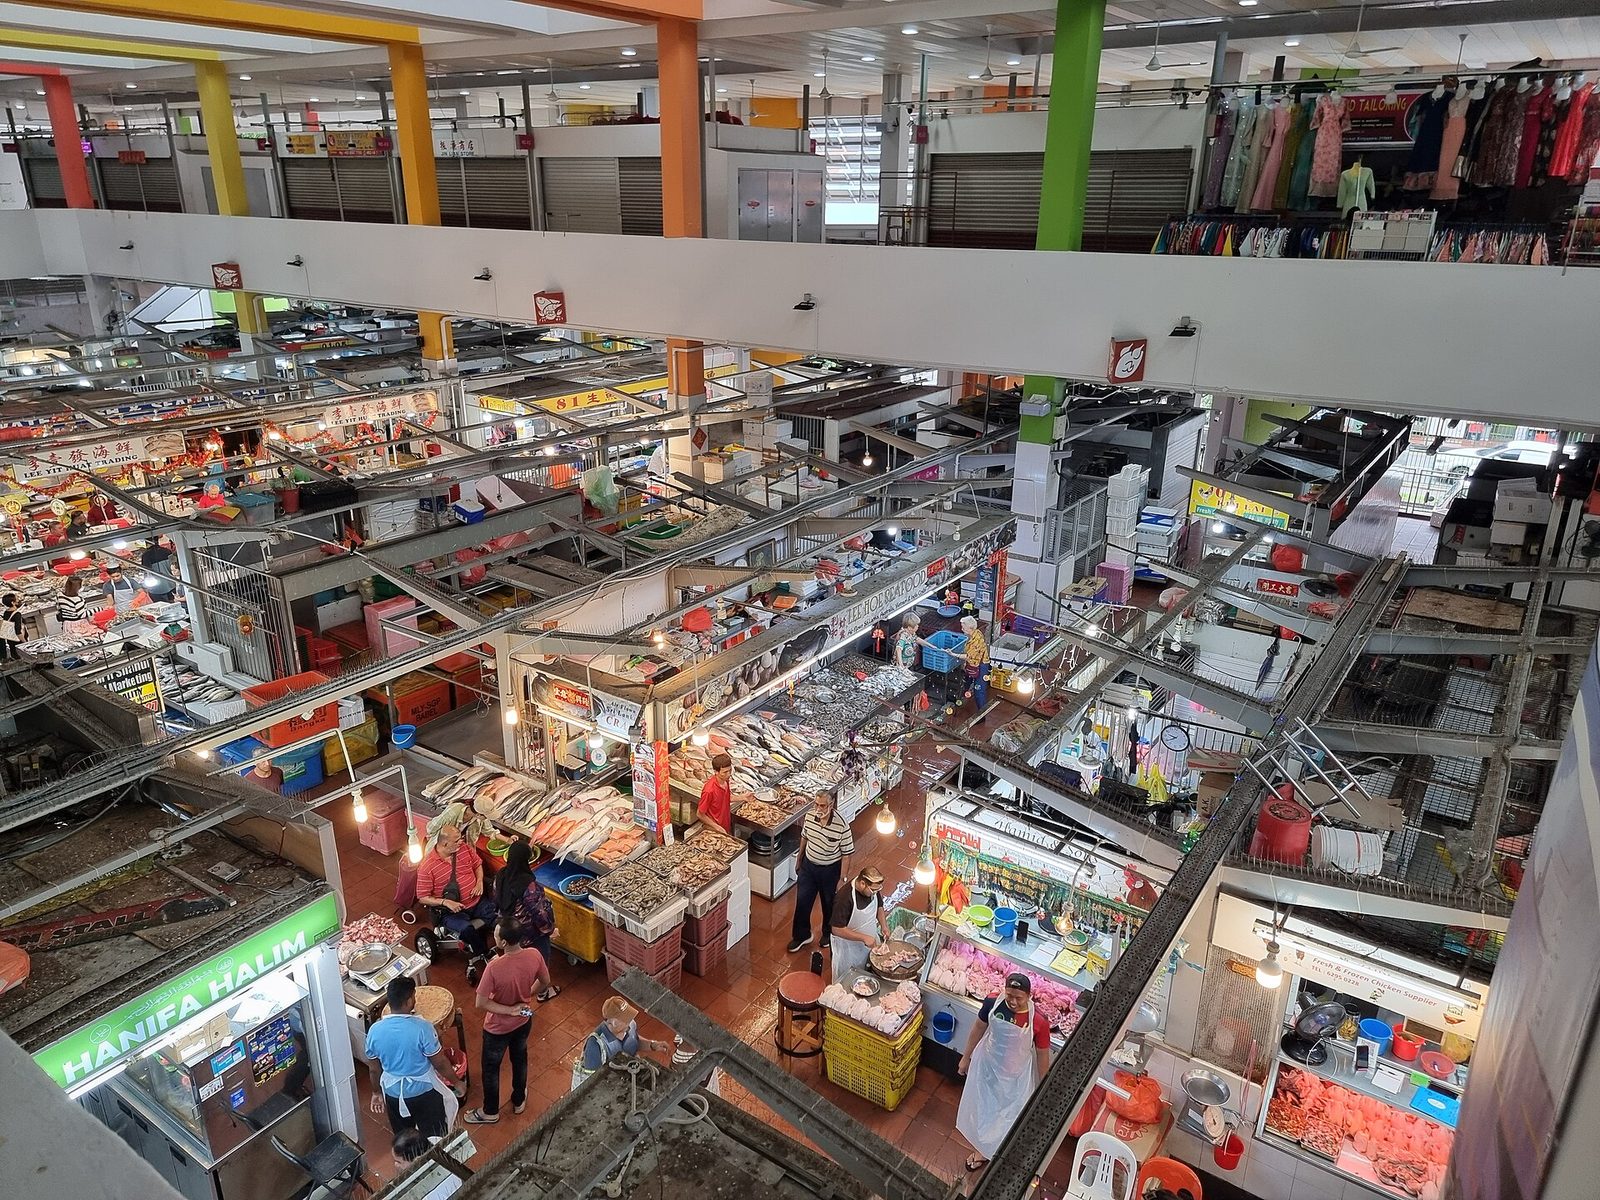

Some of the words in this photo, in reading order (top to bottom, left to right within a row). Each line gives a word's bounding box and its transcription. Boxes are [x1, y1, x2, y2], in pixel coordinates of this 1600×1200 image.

[479, 398, 489, 409] 81
[556, 396, 579, 410] 81
[377, 409, 406, 418] TRADING
[24, 470, 43, 479] LEE
[45, 467, 63, 475] YIT
[95, 454, 138, 467] TRADING
[1196, 506, 1212, 515] Fresh
[847, 605, 862, 625] LEE
[864, 592, 884, 616] HOE
[885, 570, 927, 601] SEAFOOD
[995, 818, 1046, 848] Hamid
[1065, 844, 1098, 864] Sons
[1311, 965, 1322, 974] TEL
[1312, 957, 1334, 972] Fresh
[1335, 965, 1342, 973] &
[1343, 967, 1371, 983] Frozen
[1371, 976, 1402, 995] Chicken
[1403, 990, 1438, 1008] Supplier
[64, 993, 203, 1084] HANIFA
[208, 930, 308, 1001] HALIM
